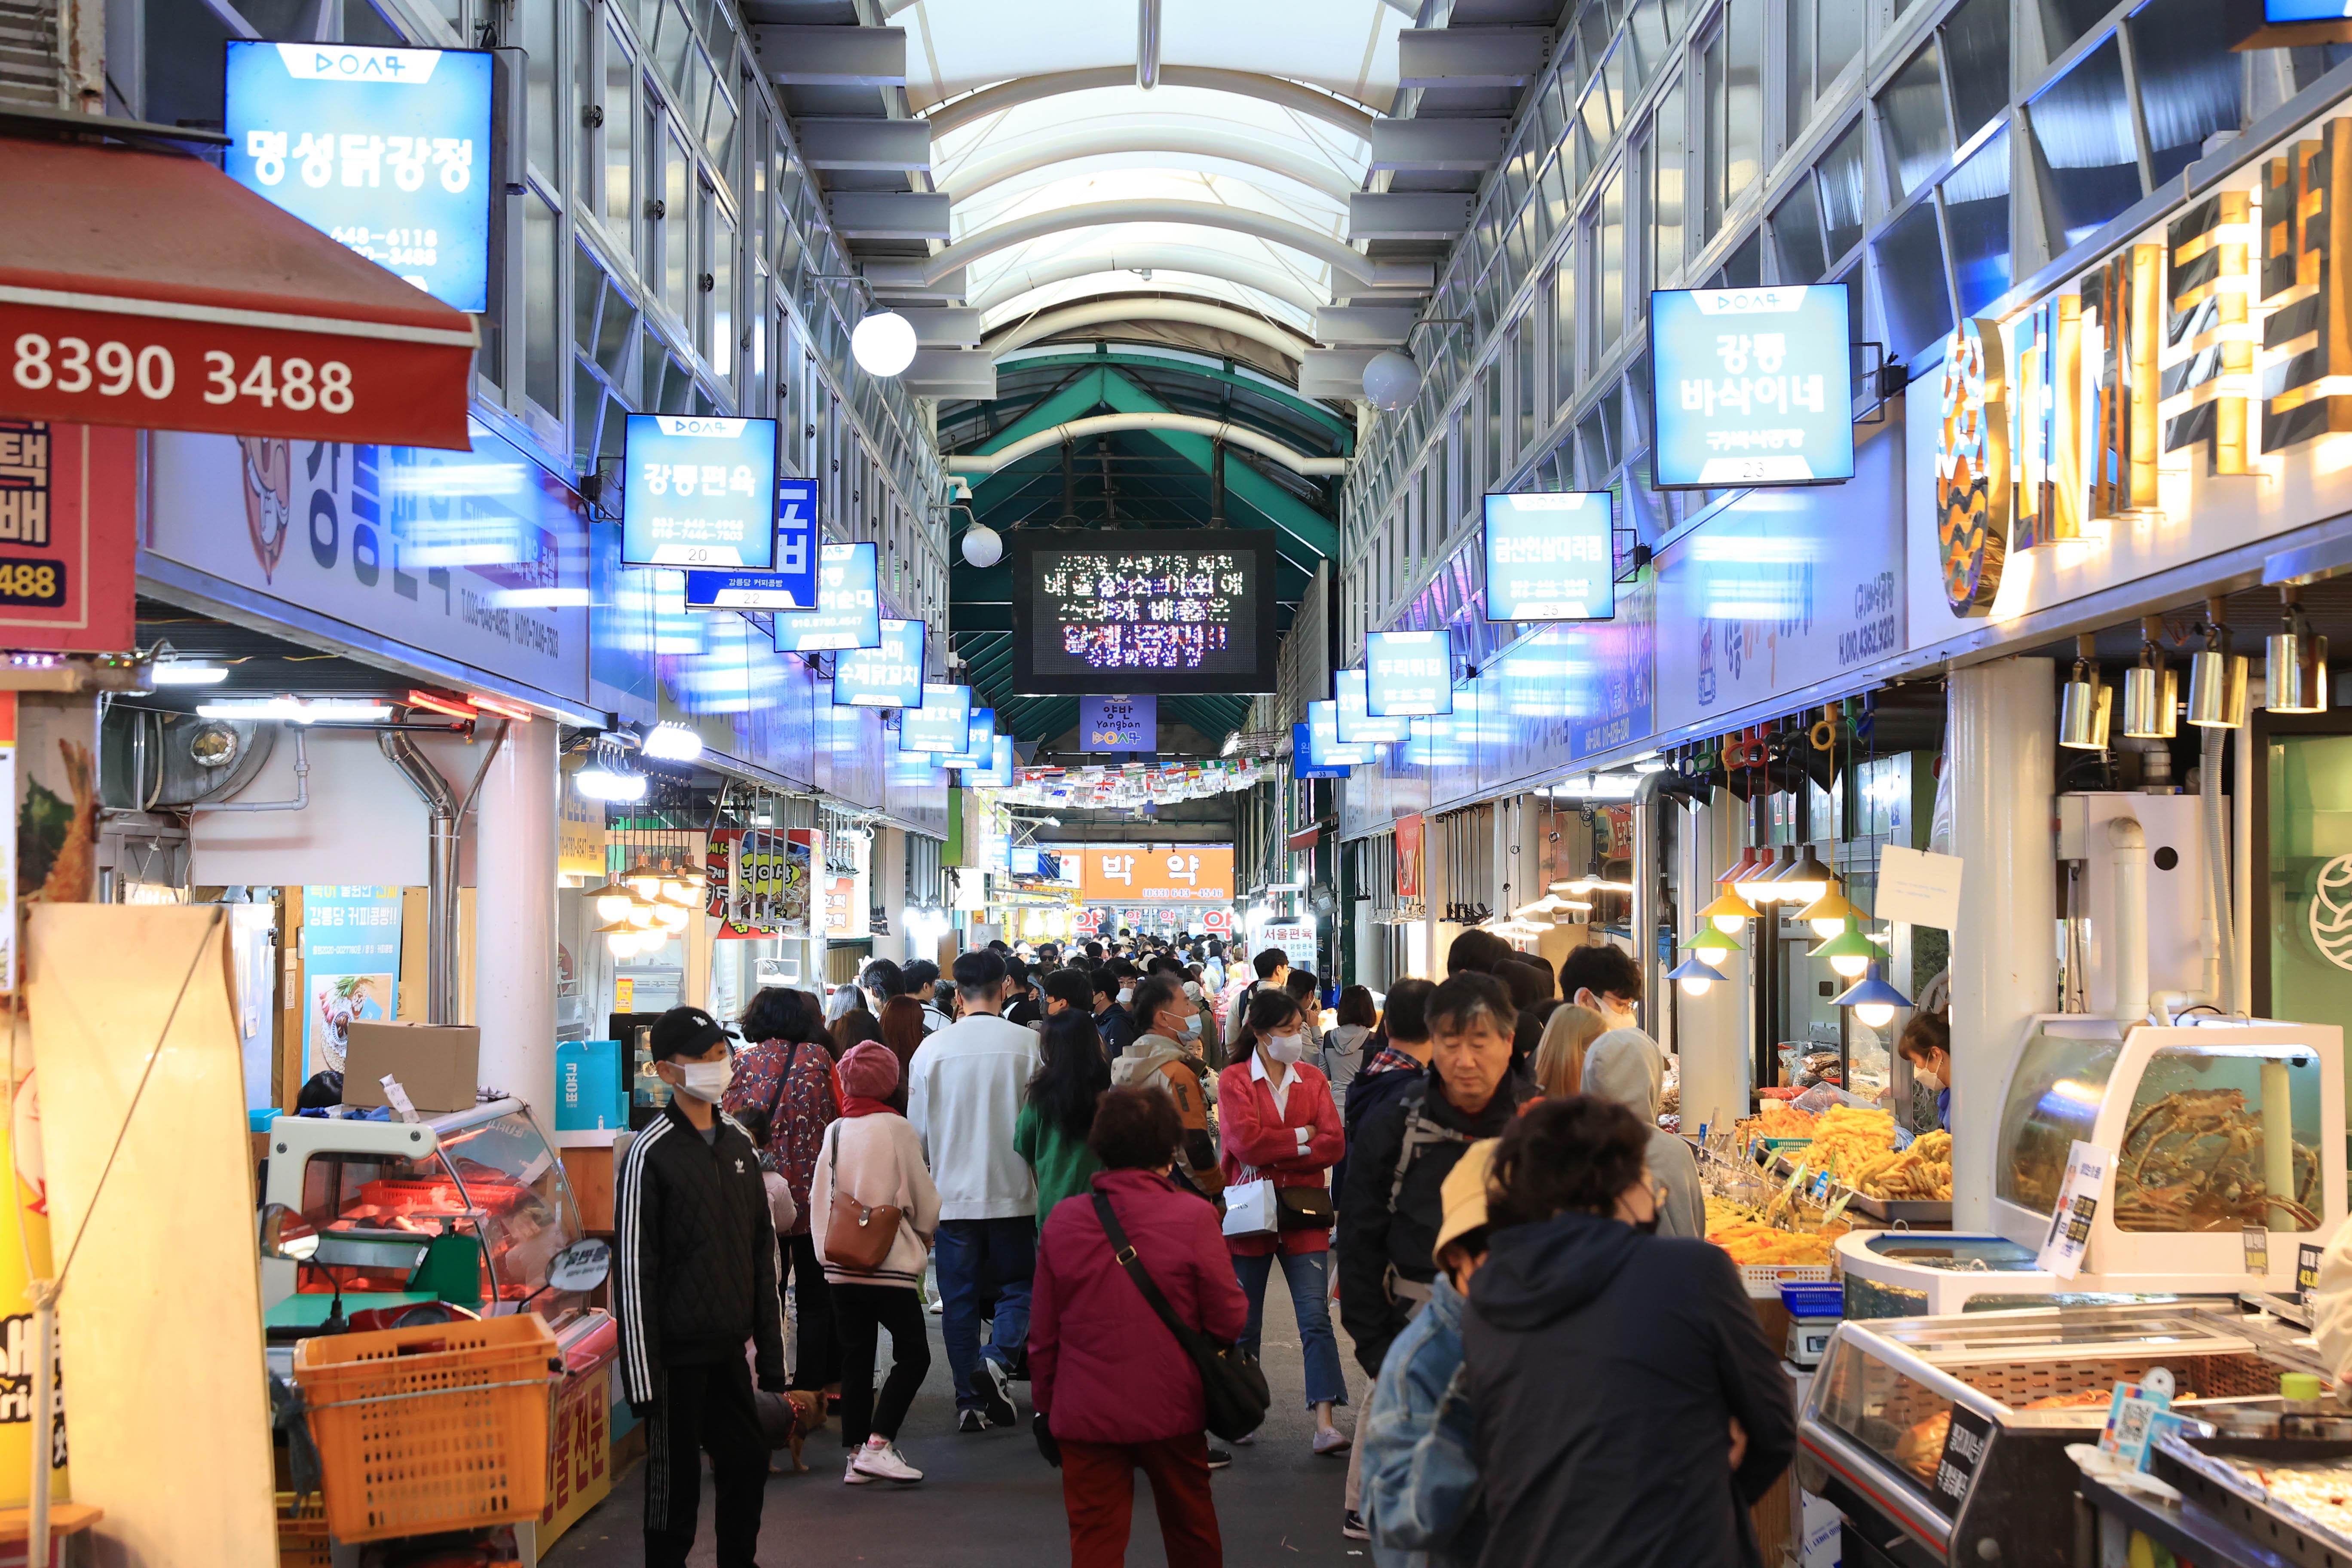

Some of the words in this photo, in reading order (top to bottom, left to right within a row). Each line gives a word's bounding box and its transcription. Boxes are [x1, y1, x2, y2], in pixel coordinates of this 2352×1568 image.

[247, 131, 472, 193] 명성닭강정
[1717, 333, 1786, 374] 강릉
[13, 334, 175, 400] 8390
[203, 350, 355, 414] 3488
[1681, 374, 1824, 416] 바삭이네
[1743, 462, 1764, 478] 23
[644, 463, 756, 497] 강릉편육
[688, 548, 707, 561] 20
[729, 578, 752, 587] 강릉당
[753, 578, 783, 588] 커피콩빵
[744, 593, 760, 604] 22
[1543, 605, 1558, 616] 25
[820, 636, 836, 649] 24
[1103, 704, 1133, 720] 양반
[1096, 720, 1140, 729] Yangban
[1102, 854, 1135, 886] 박
[1167, 854, 1200, 886] 약
[1142, 888, 1169, 898] (033)
[1171, 888, 1224, 898] 643-4546
[309, 906, 345, 926] 강릉당
[348, 906, 398, 926] 커피콩빵!!
[1125, 910, 1142, 927] 약
[1160, 909, 1176, 926] 약
[1264, 928, 1313, 940] 서울편육
